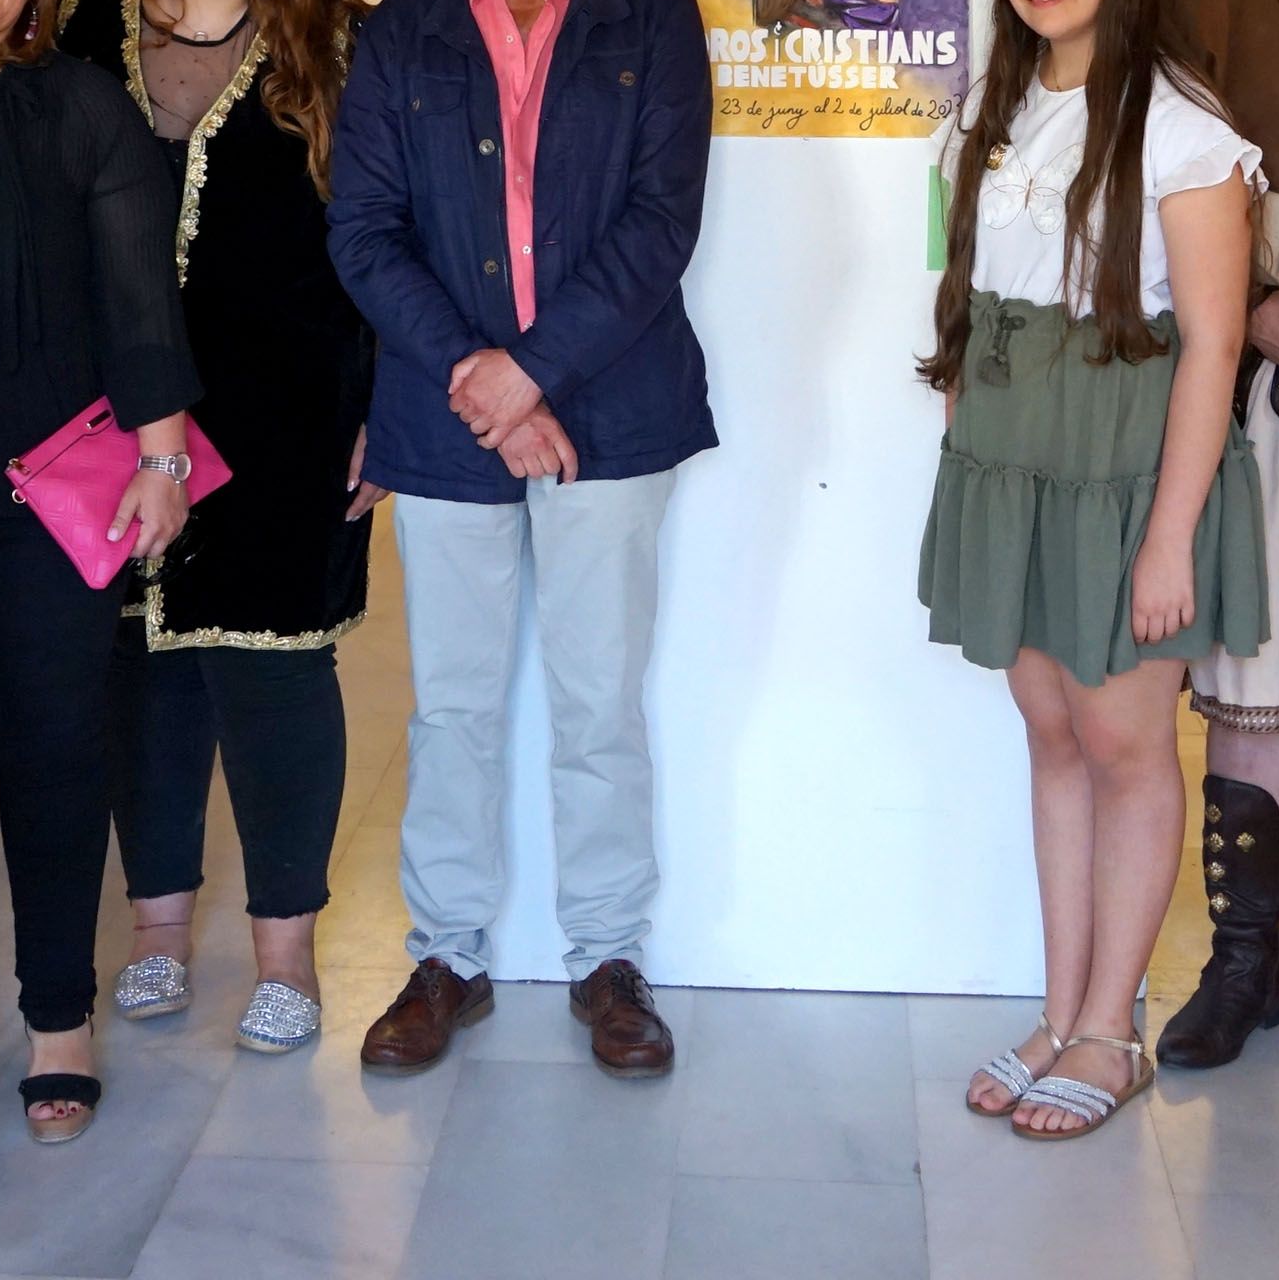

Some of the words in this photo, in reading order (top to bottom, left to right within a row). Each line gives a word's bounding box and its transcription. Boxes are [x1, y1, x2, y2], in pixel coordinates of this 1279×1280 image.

[706, 28, 769, 62] ROS
[784, 28, 957, 65] CRISTIANS
[717, 60, 899, 89] BENETÚSSER
[720, 97, 741, 114] 23
[747, 100, 762, 115] de
[762, 107, 808, 130] juny
[814, 97, 827, 113] al
[833, 97, 844, 114] 2
[849, 102, 862, 115] de
[859, 97, 911, 131] juliol
[911, 102, 924, 116] de
